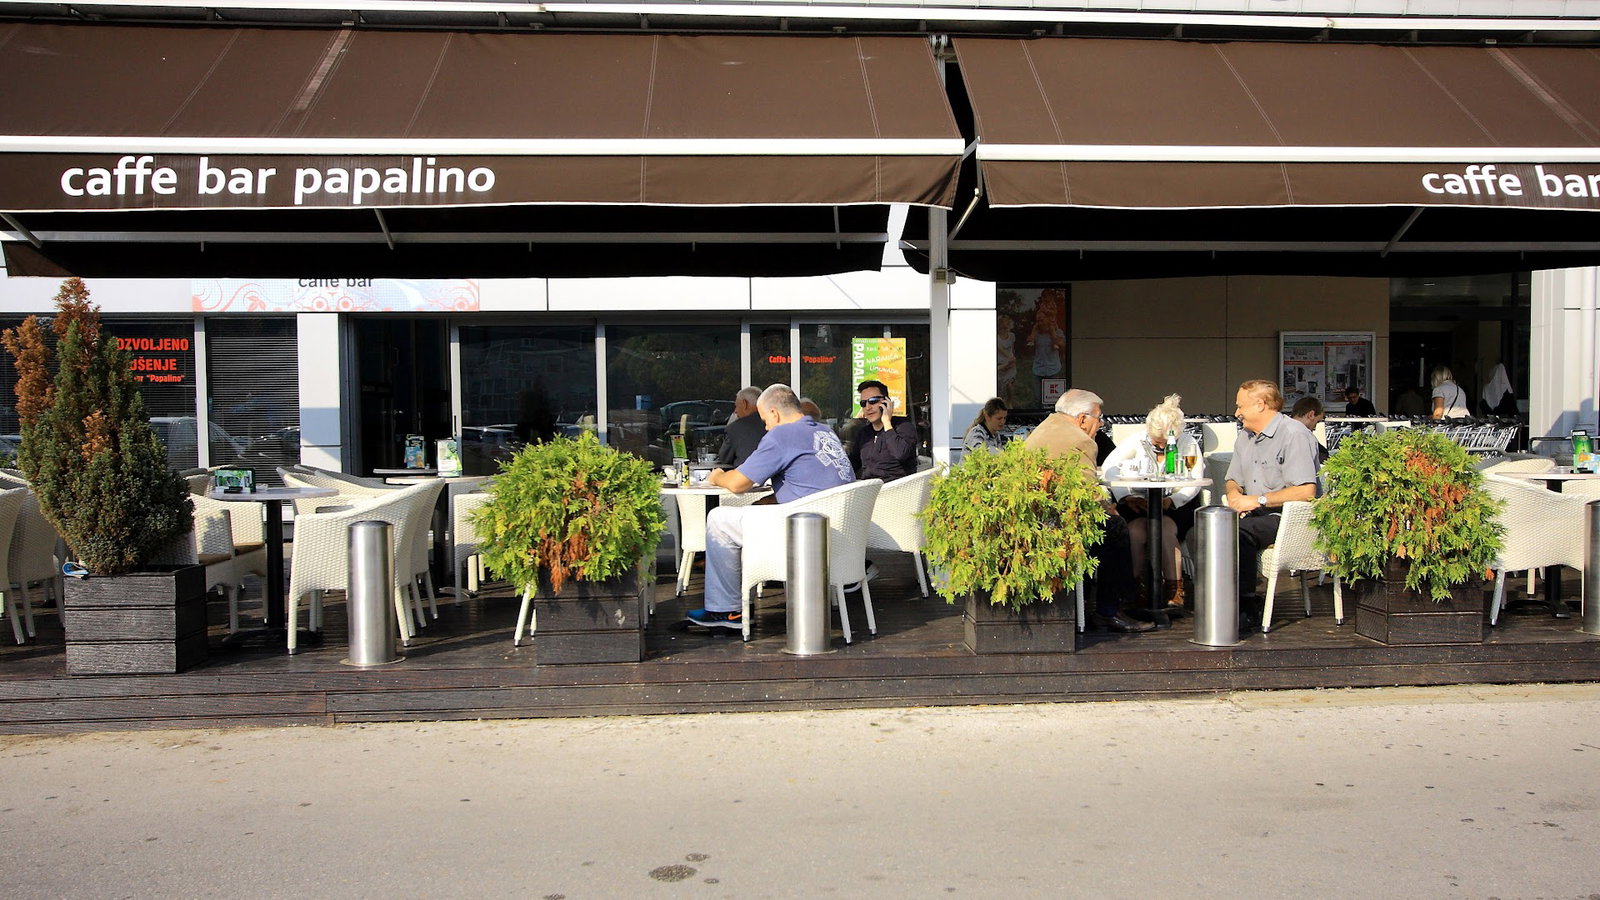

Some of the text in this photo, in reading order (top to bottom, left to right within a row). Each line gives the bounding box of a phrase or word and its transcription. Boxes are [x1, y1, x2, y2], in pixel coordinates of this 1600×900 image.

[61, 155, 496, 205] caffe bar papalino
[1422, 164, 1600, 197] caffe bar
[115, 338, 189, 351] OZVOLJENO
[129, 356, 177, 371] UŠENJE
[769, 355, 787, 363] Caffe
